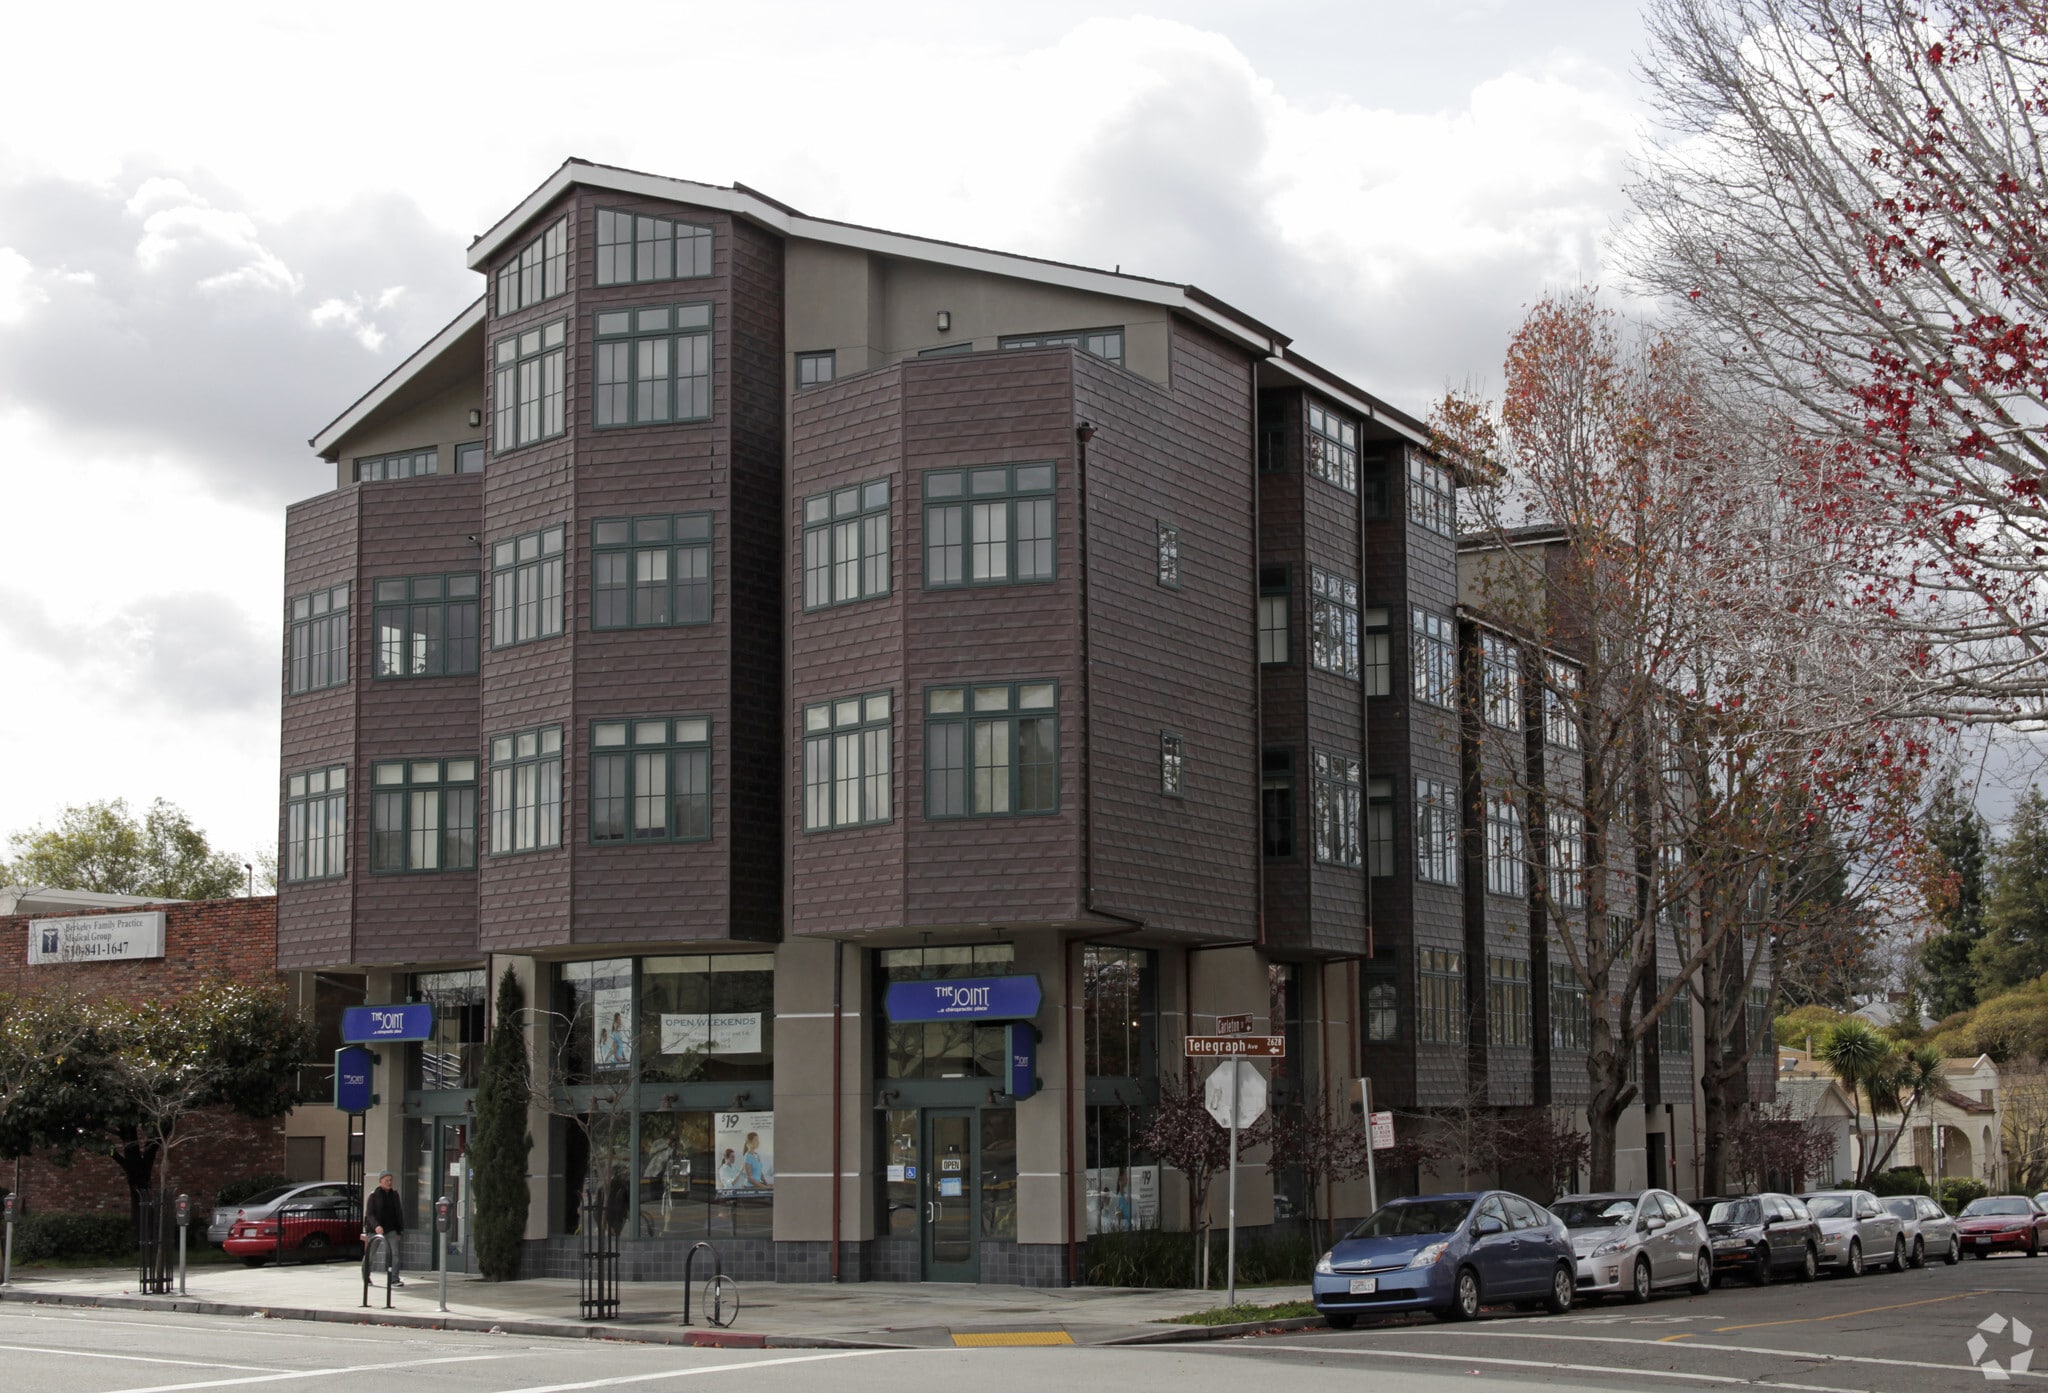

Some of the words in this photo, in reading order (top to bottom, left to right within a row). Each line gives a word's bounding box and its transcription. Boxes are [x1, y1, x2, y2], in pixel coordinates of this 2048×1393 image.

[94, 921, 115, 930] Family
[117, 919, 144, 928] Practice
[65, 933, 90, 942] Medical
[91, 932, 112, 942] Group
[934, 986, 953, 997] THE
[952, 987, 990, 1007] JOINT
[381, 1013, 404, 1030] JOINT
[665, 1018, 694, 1027] OPEN
[696, 1017, 756, 1027] WEEKENDS
[1217, 1018, 1241, 1034] Carleton
[1189, 1039, 1246, 1055] Telegraph
[1266, 1038, 1282, 1046] 2628
[721, 1114, 740, 1128] $19
[943, 1160, 960, 1169] OPEN
